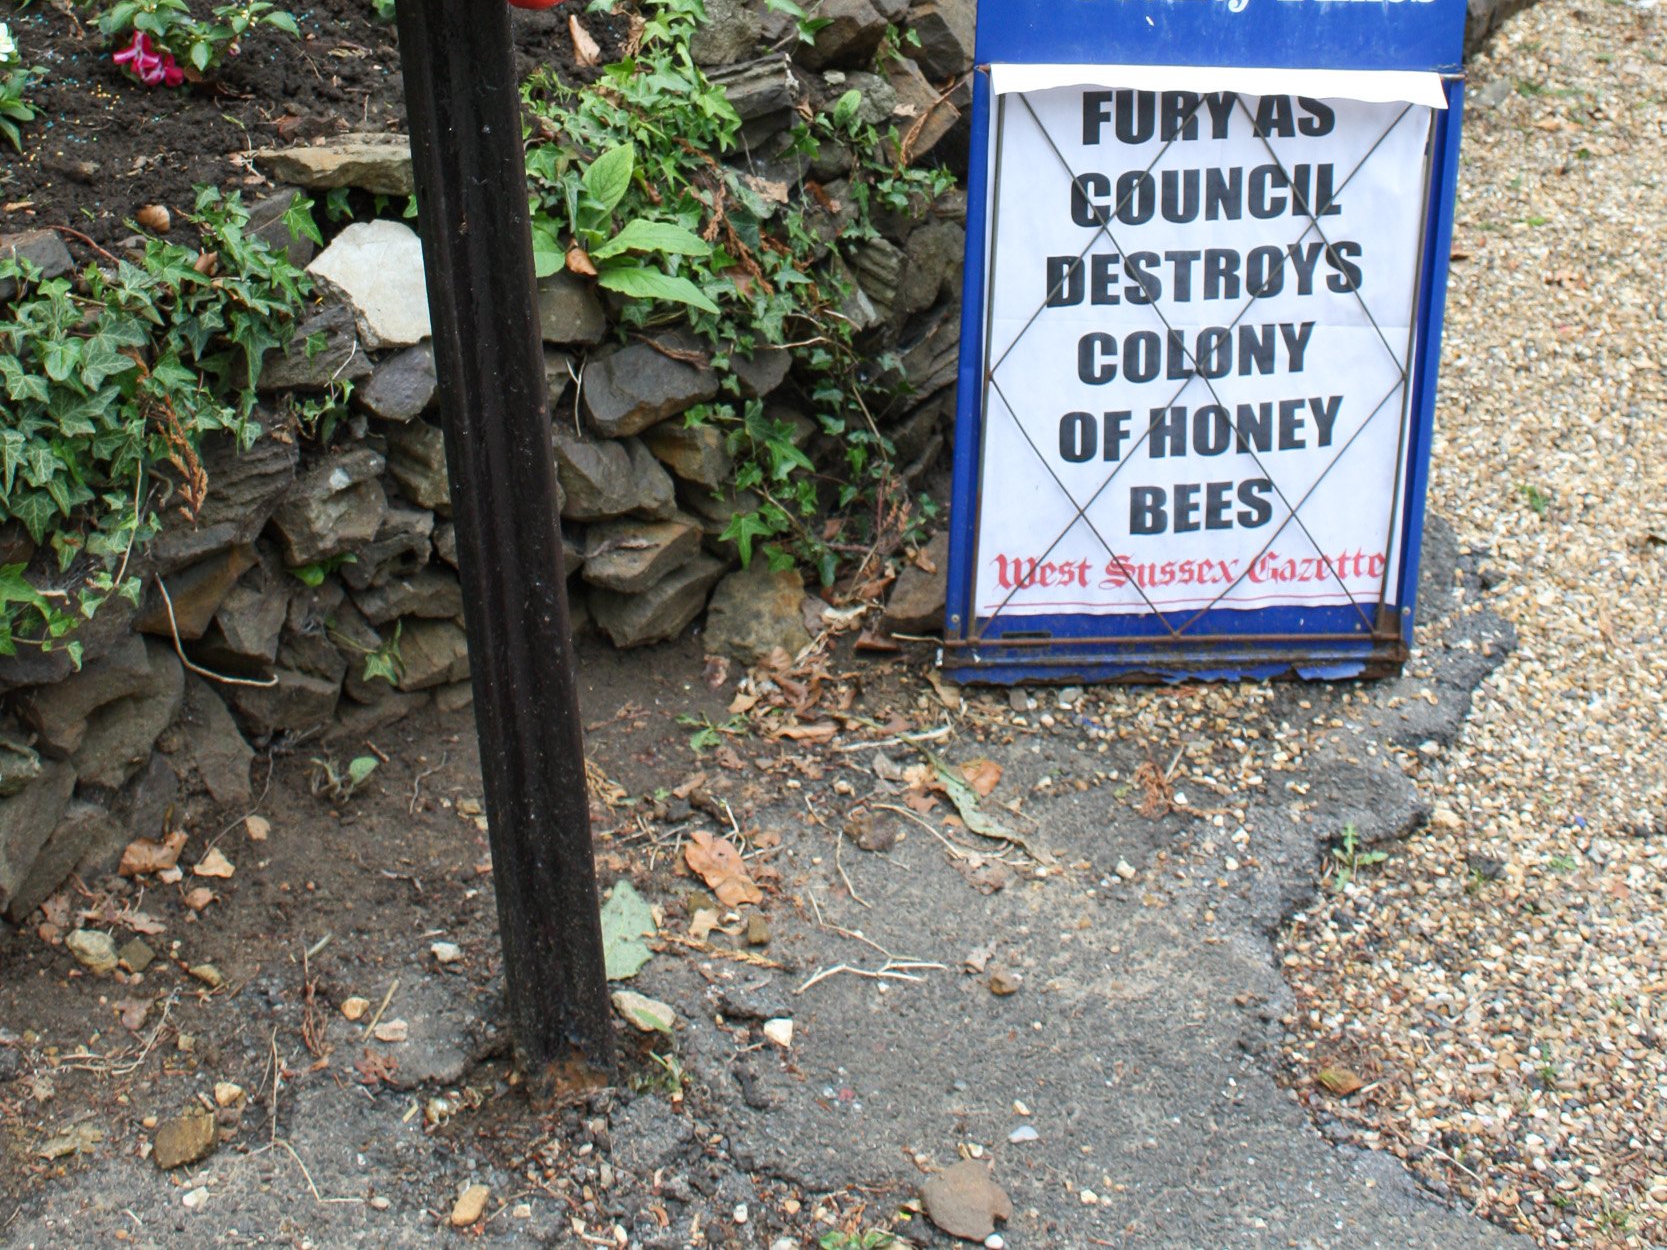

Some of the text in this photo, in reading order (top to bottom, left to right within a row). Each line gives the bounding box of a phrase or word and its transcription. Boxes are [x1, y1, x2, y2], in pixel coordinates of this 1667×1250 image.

[1082, 90, 1336, 145] FURY AS
[1070, 163, 1341, 228] COUNCIL
[1045, 241, 1363, 309] DESTROYS
[1077, 321, 1315, 385] COLONY
[1058, 396, 1344, 464] OF HONEY
[1129, 478, 1274, 535] BEES
[990, 546, 1387, 590] West Sussex Gazette
